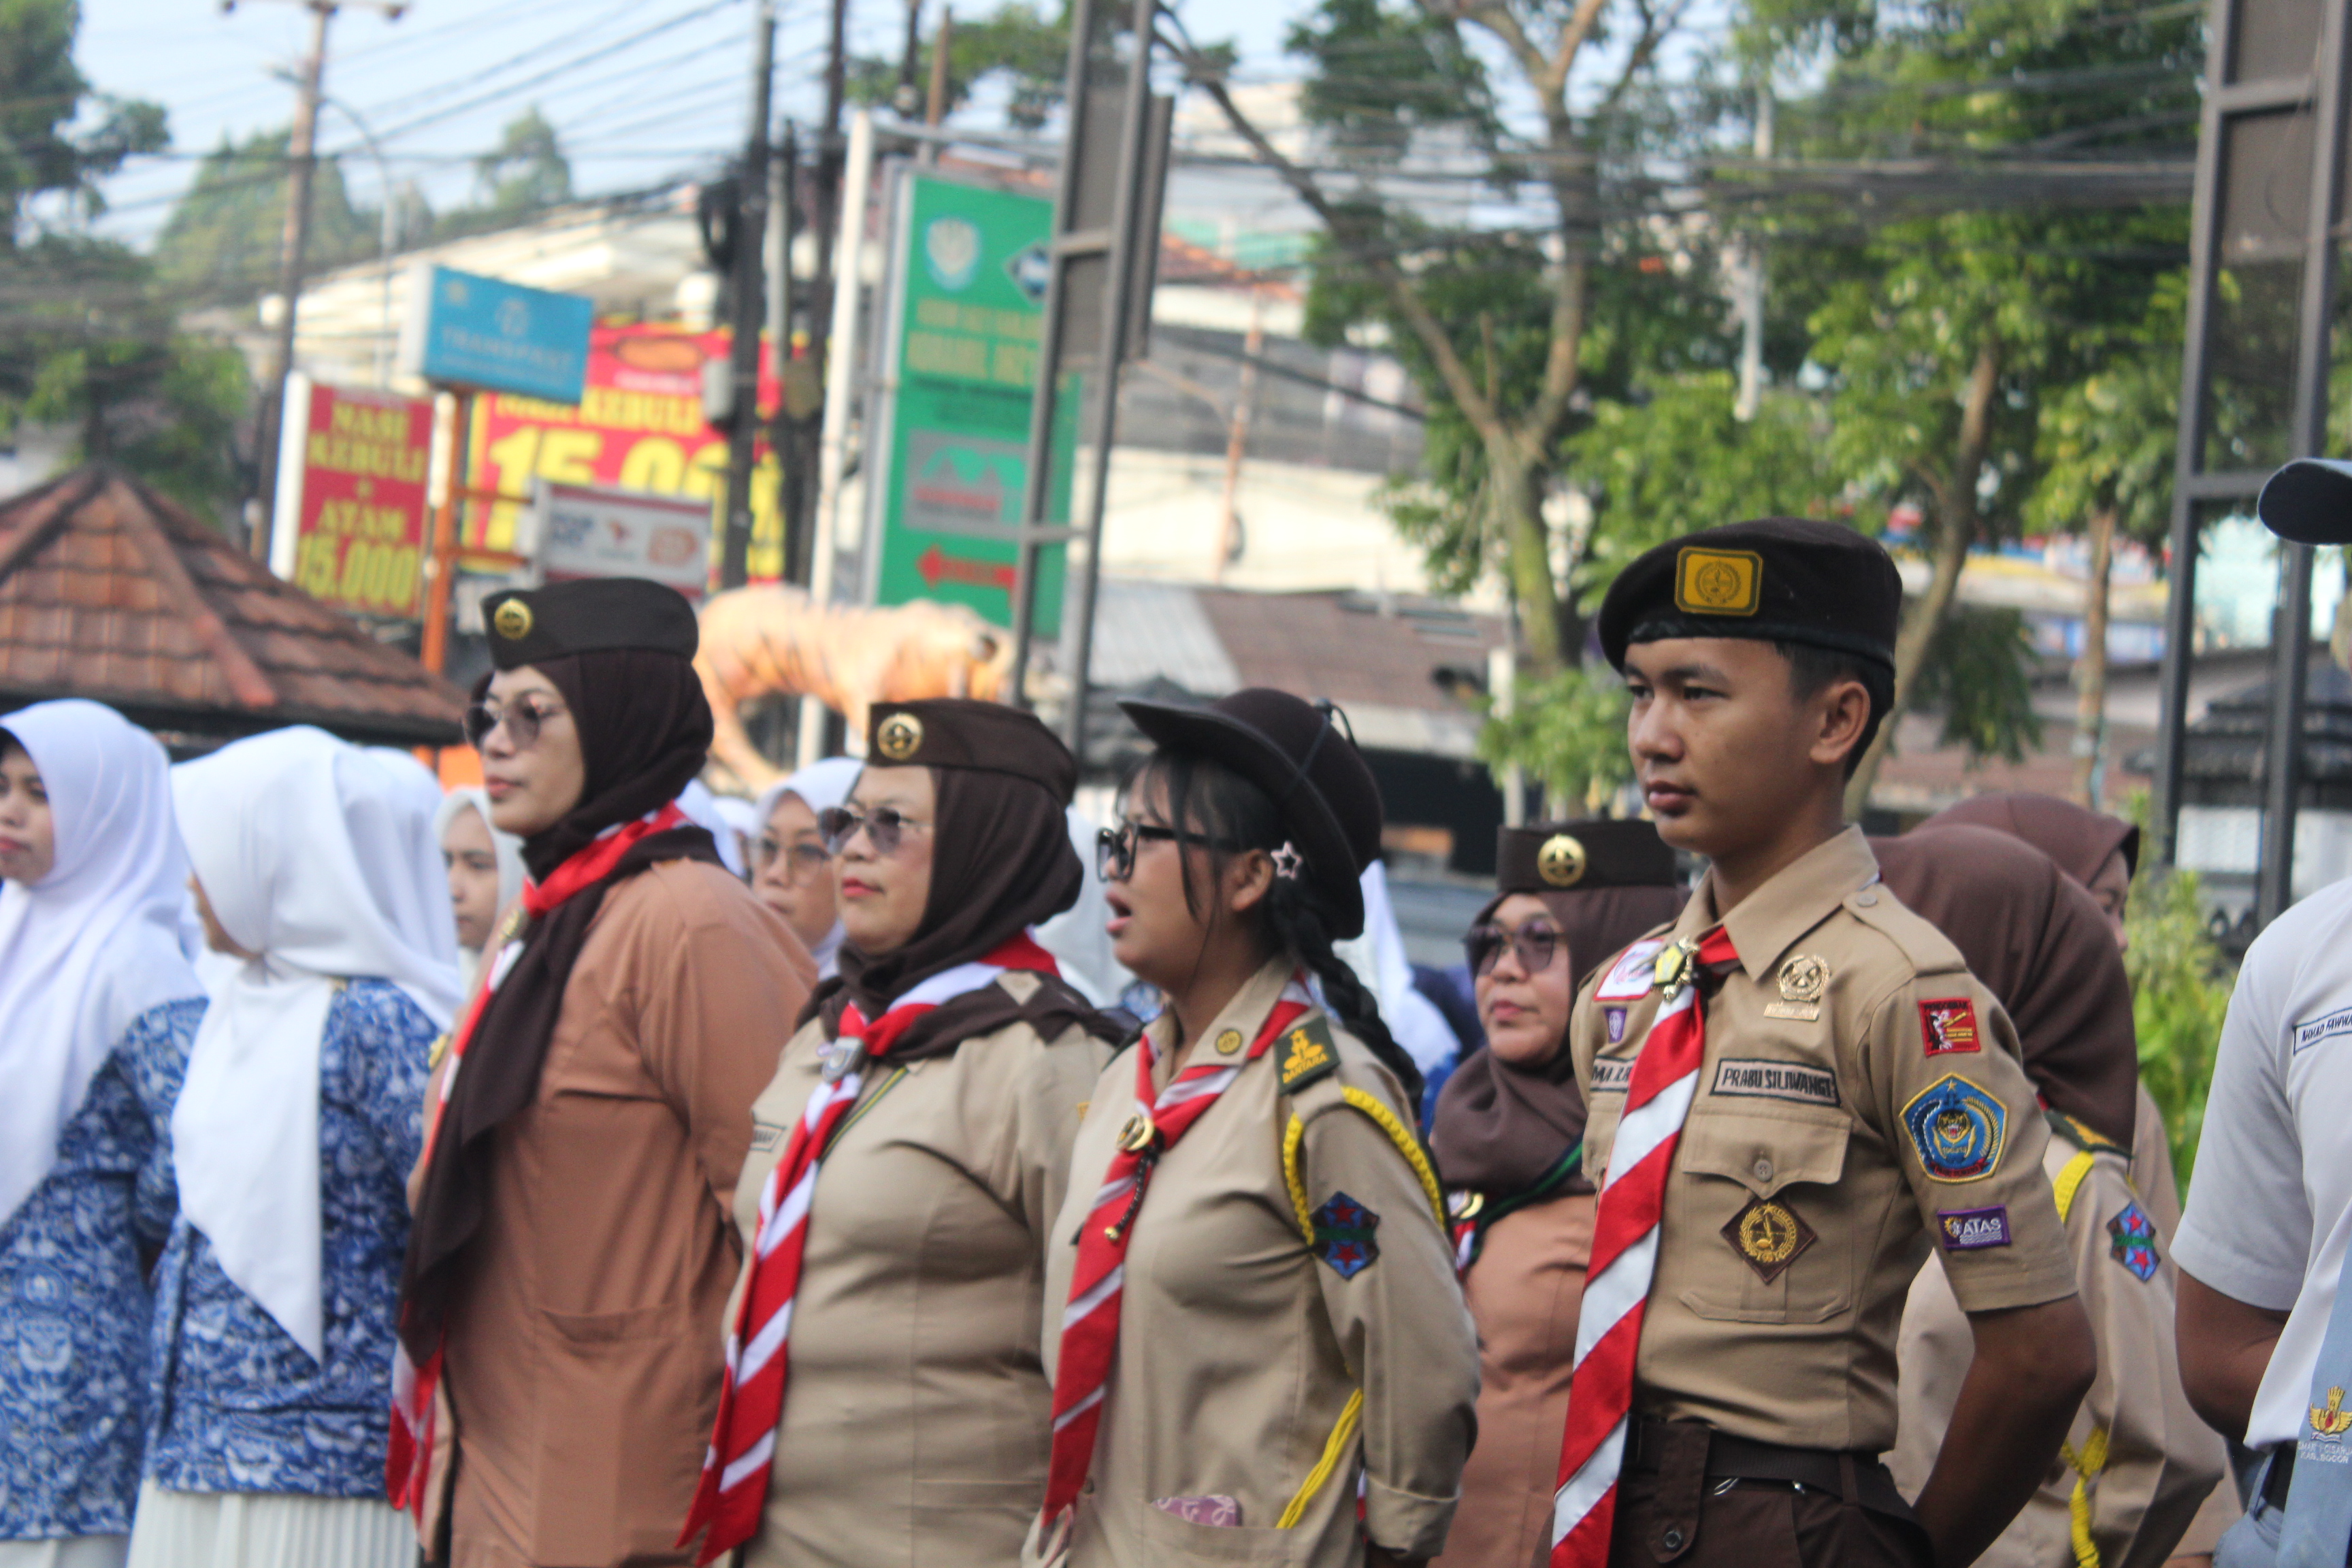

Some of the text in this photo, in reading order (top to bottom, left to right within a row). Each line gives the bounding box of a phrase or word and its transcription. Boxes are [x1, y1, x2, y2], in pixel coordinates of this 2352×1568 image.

[331, 400, 406, 440] NASI
[308, 433, 425, 484] KEBULI
[320, 498, 404, 542] AYAM
[295, 532, 419, 610] 15.000
[1282, 1053, 1328, 1084] BANTARA
[1721, 1068, 1831, 1098] PRABU SILIWANGI
